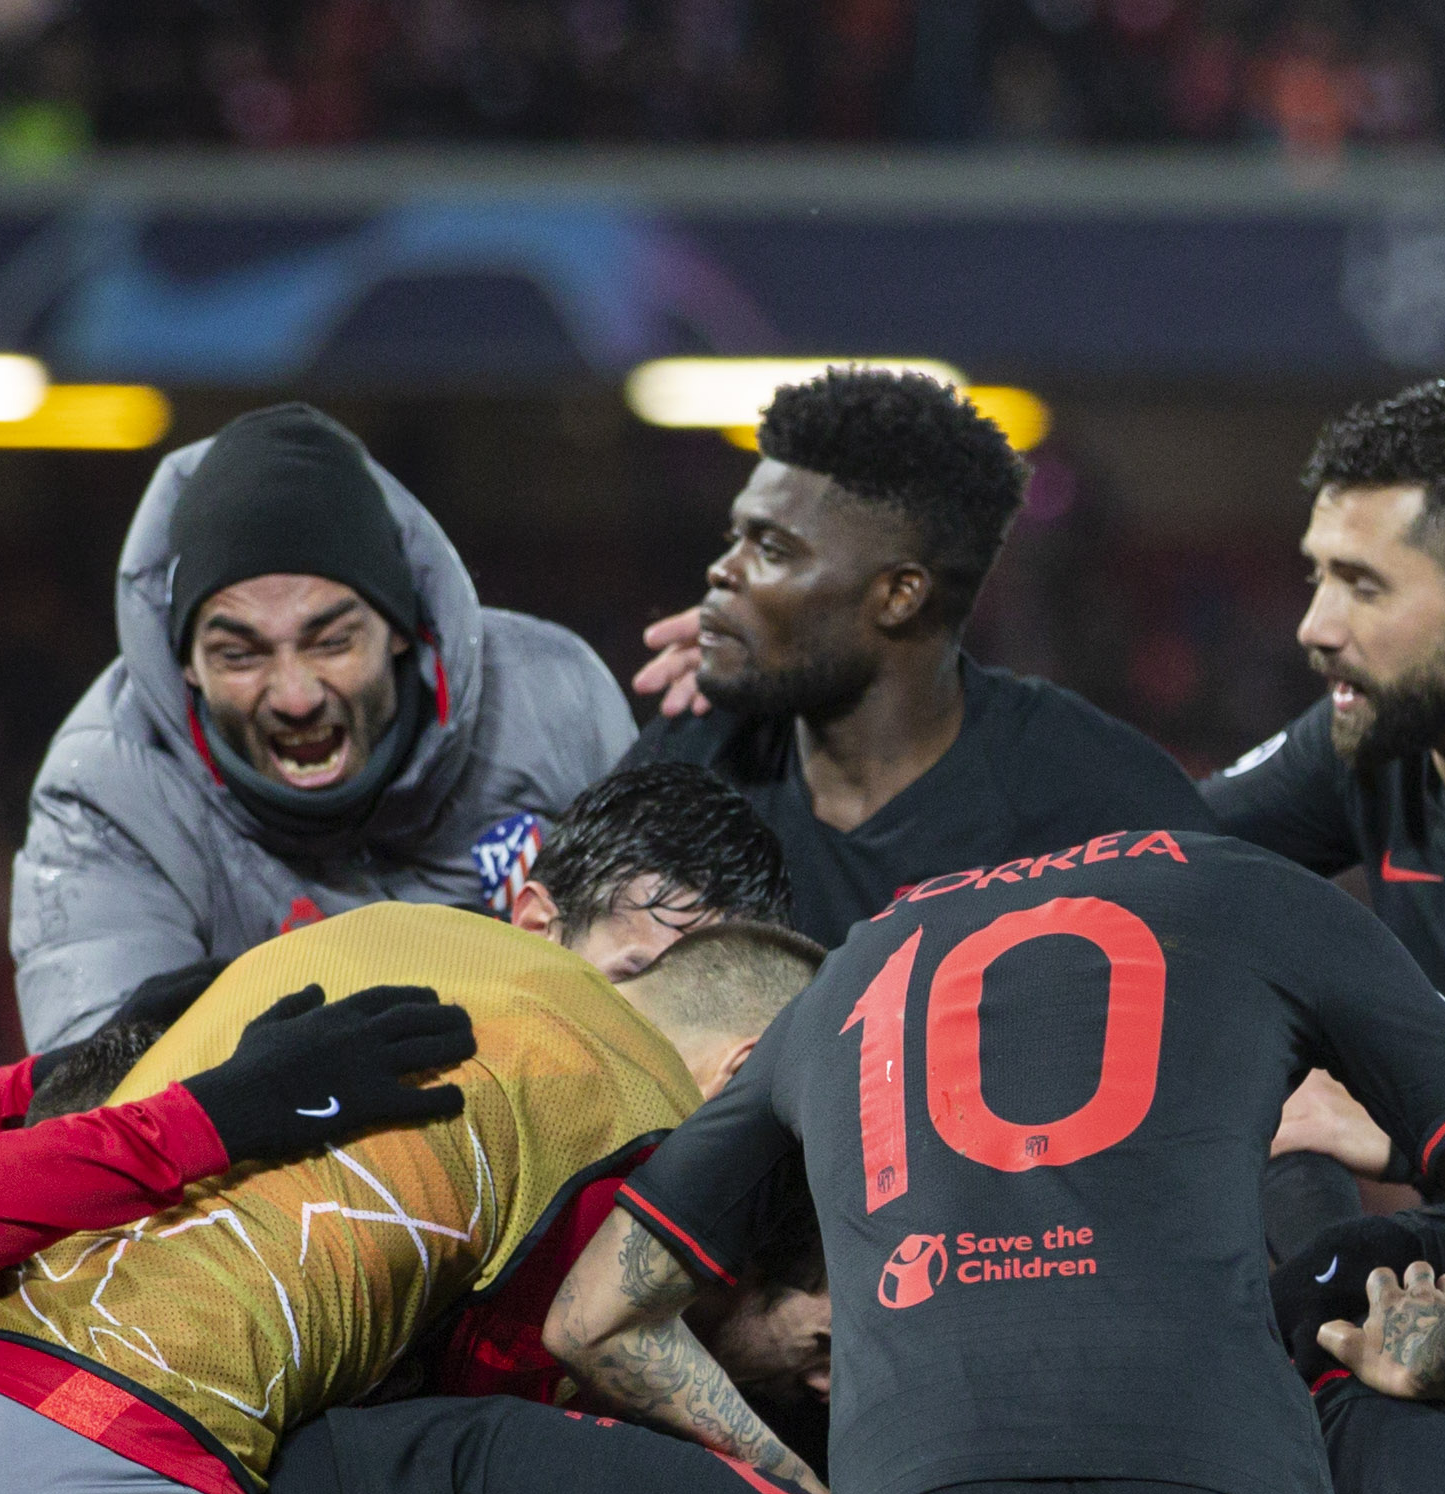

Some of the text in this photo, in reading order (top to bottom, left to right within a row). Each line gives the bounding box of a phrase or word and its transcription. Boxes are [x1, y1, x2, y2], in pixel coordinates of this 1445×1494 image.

[839, 896, 1167, 1215] 10
[956, 1225, 1094, 1255] Save the
[956, 1257, 1097, 1284] Children
